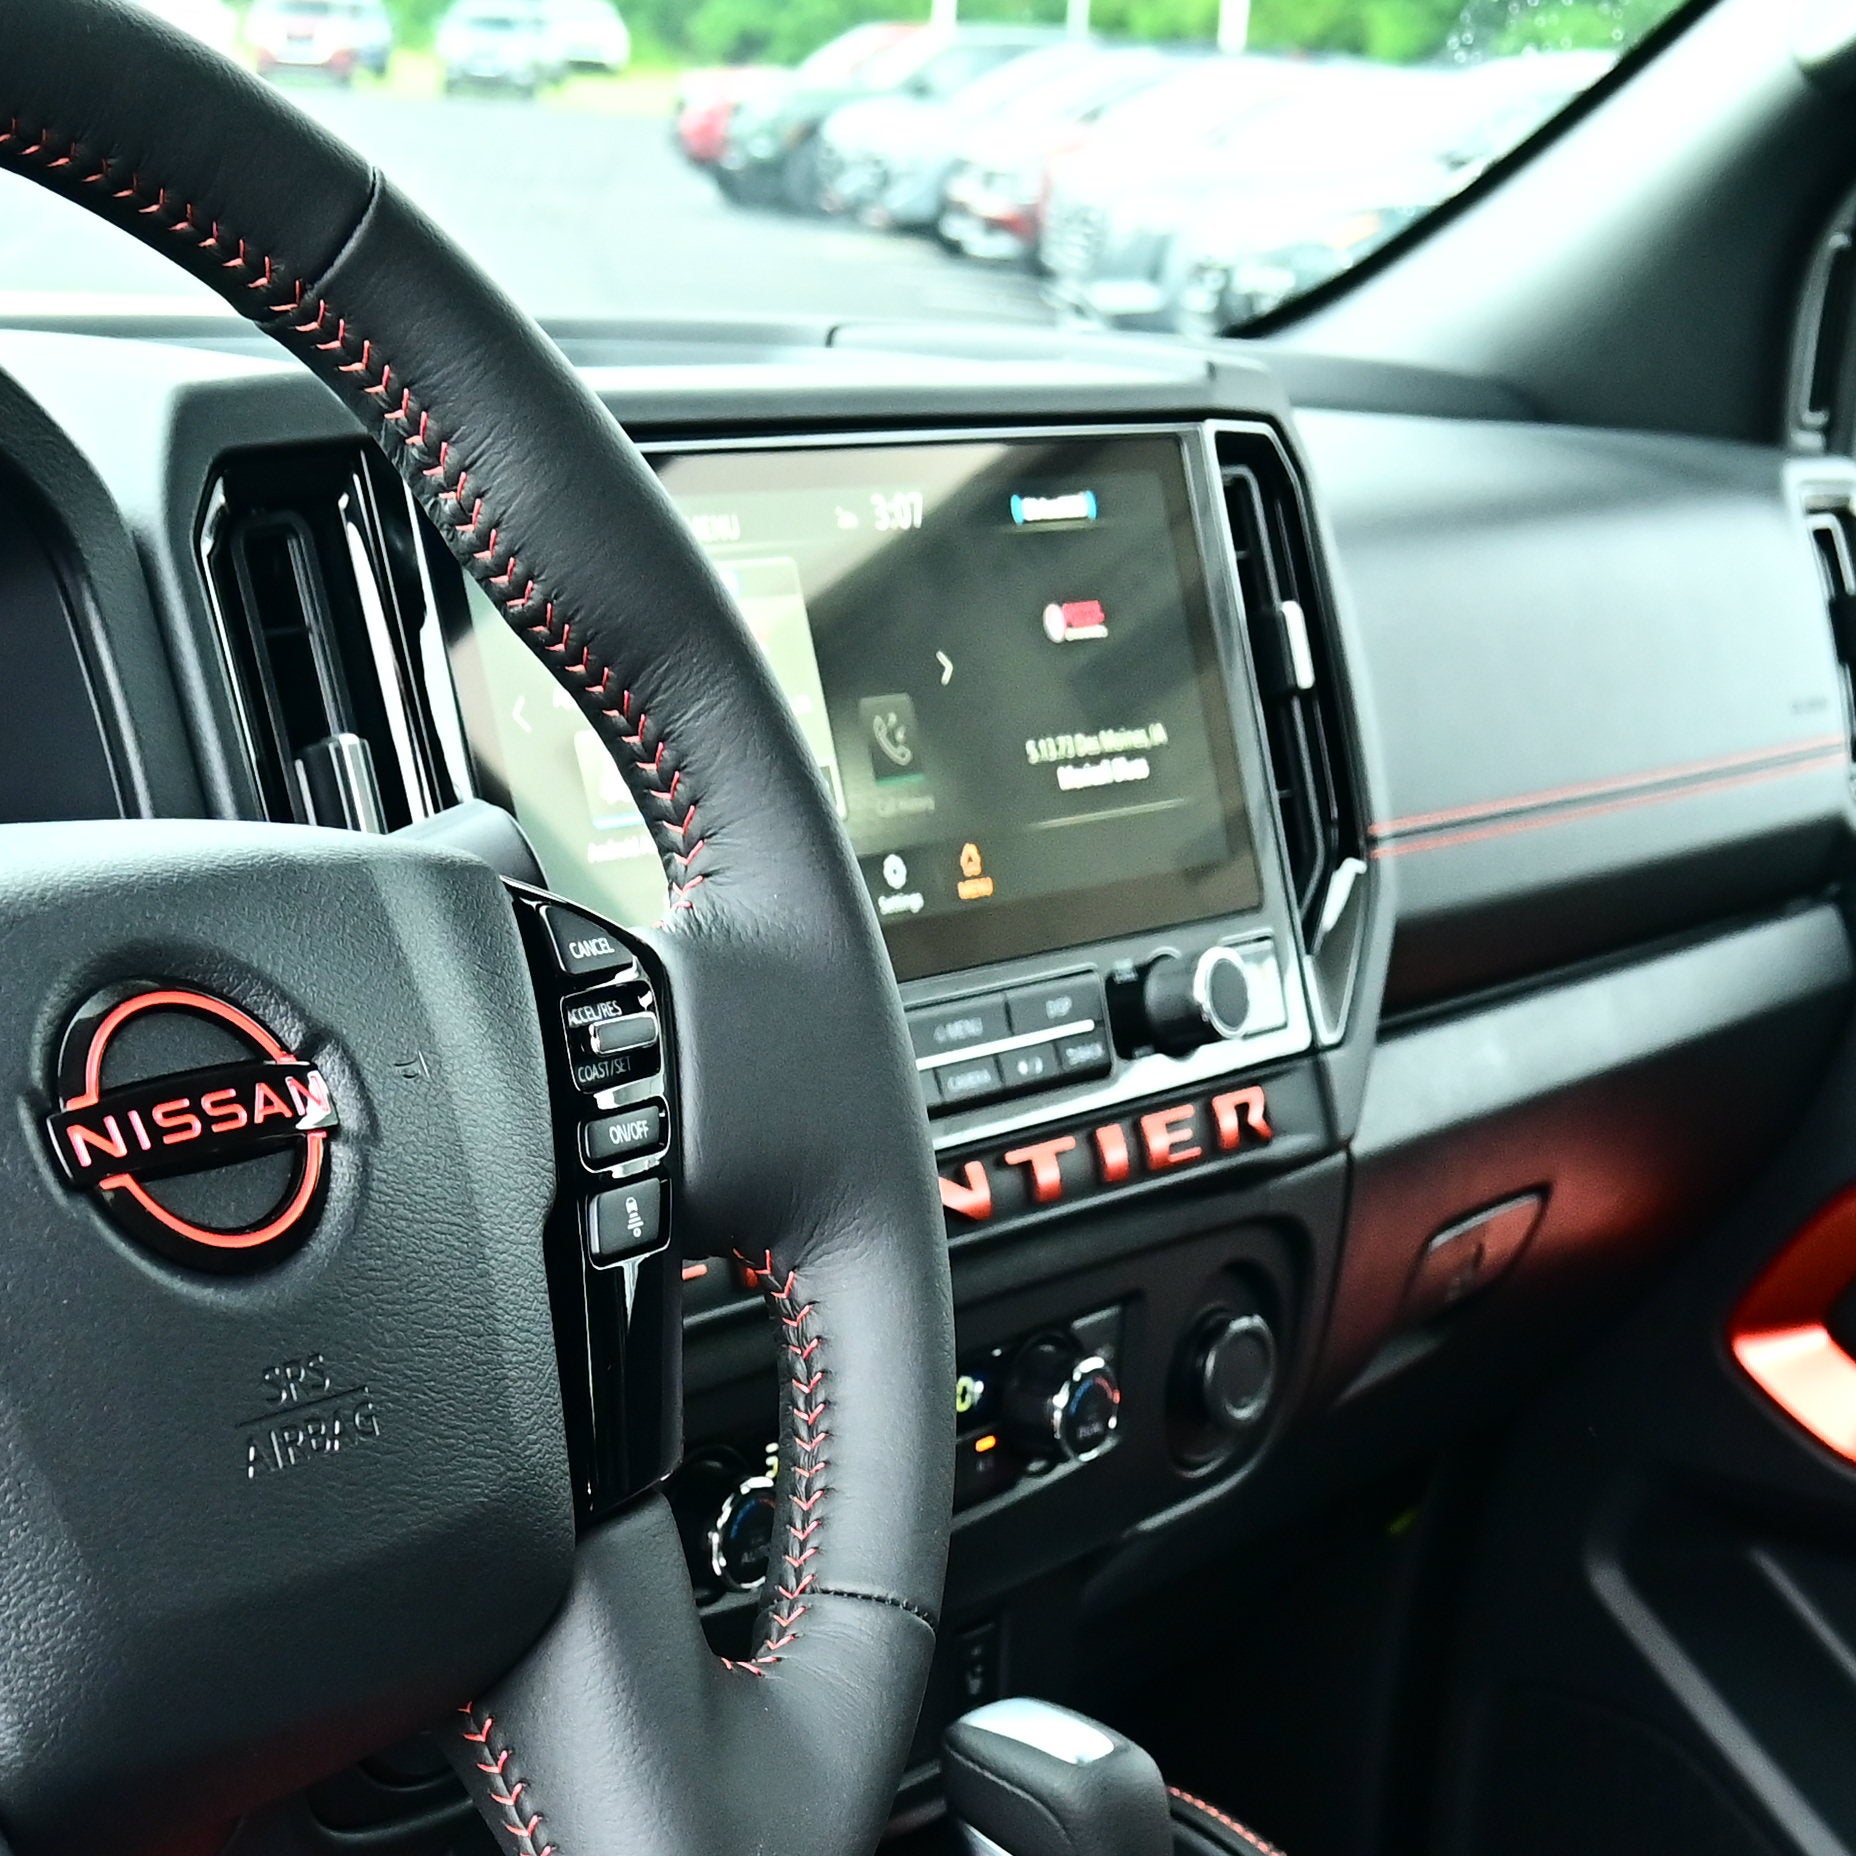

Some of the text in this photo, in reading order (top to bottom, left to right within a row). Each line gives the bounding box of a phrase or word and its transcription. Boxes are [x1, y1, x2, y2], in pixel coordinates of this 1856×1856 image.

[870, 491, 924, 532] 3:07
[569, 936, 616, 960] CANCEL
[566, 1000, 623, 1028] ACCEL/RES
[577, 1055, 632, 1084] COAST/SET
[65, 1069, 334, 1168] NISSAN
[609, 1120, 650, 1146] ON/OFF
[260, 1351, 333, 1407] SRS
[244, 1400, 383, 1481] AIRBAG
